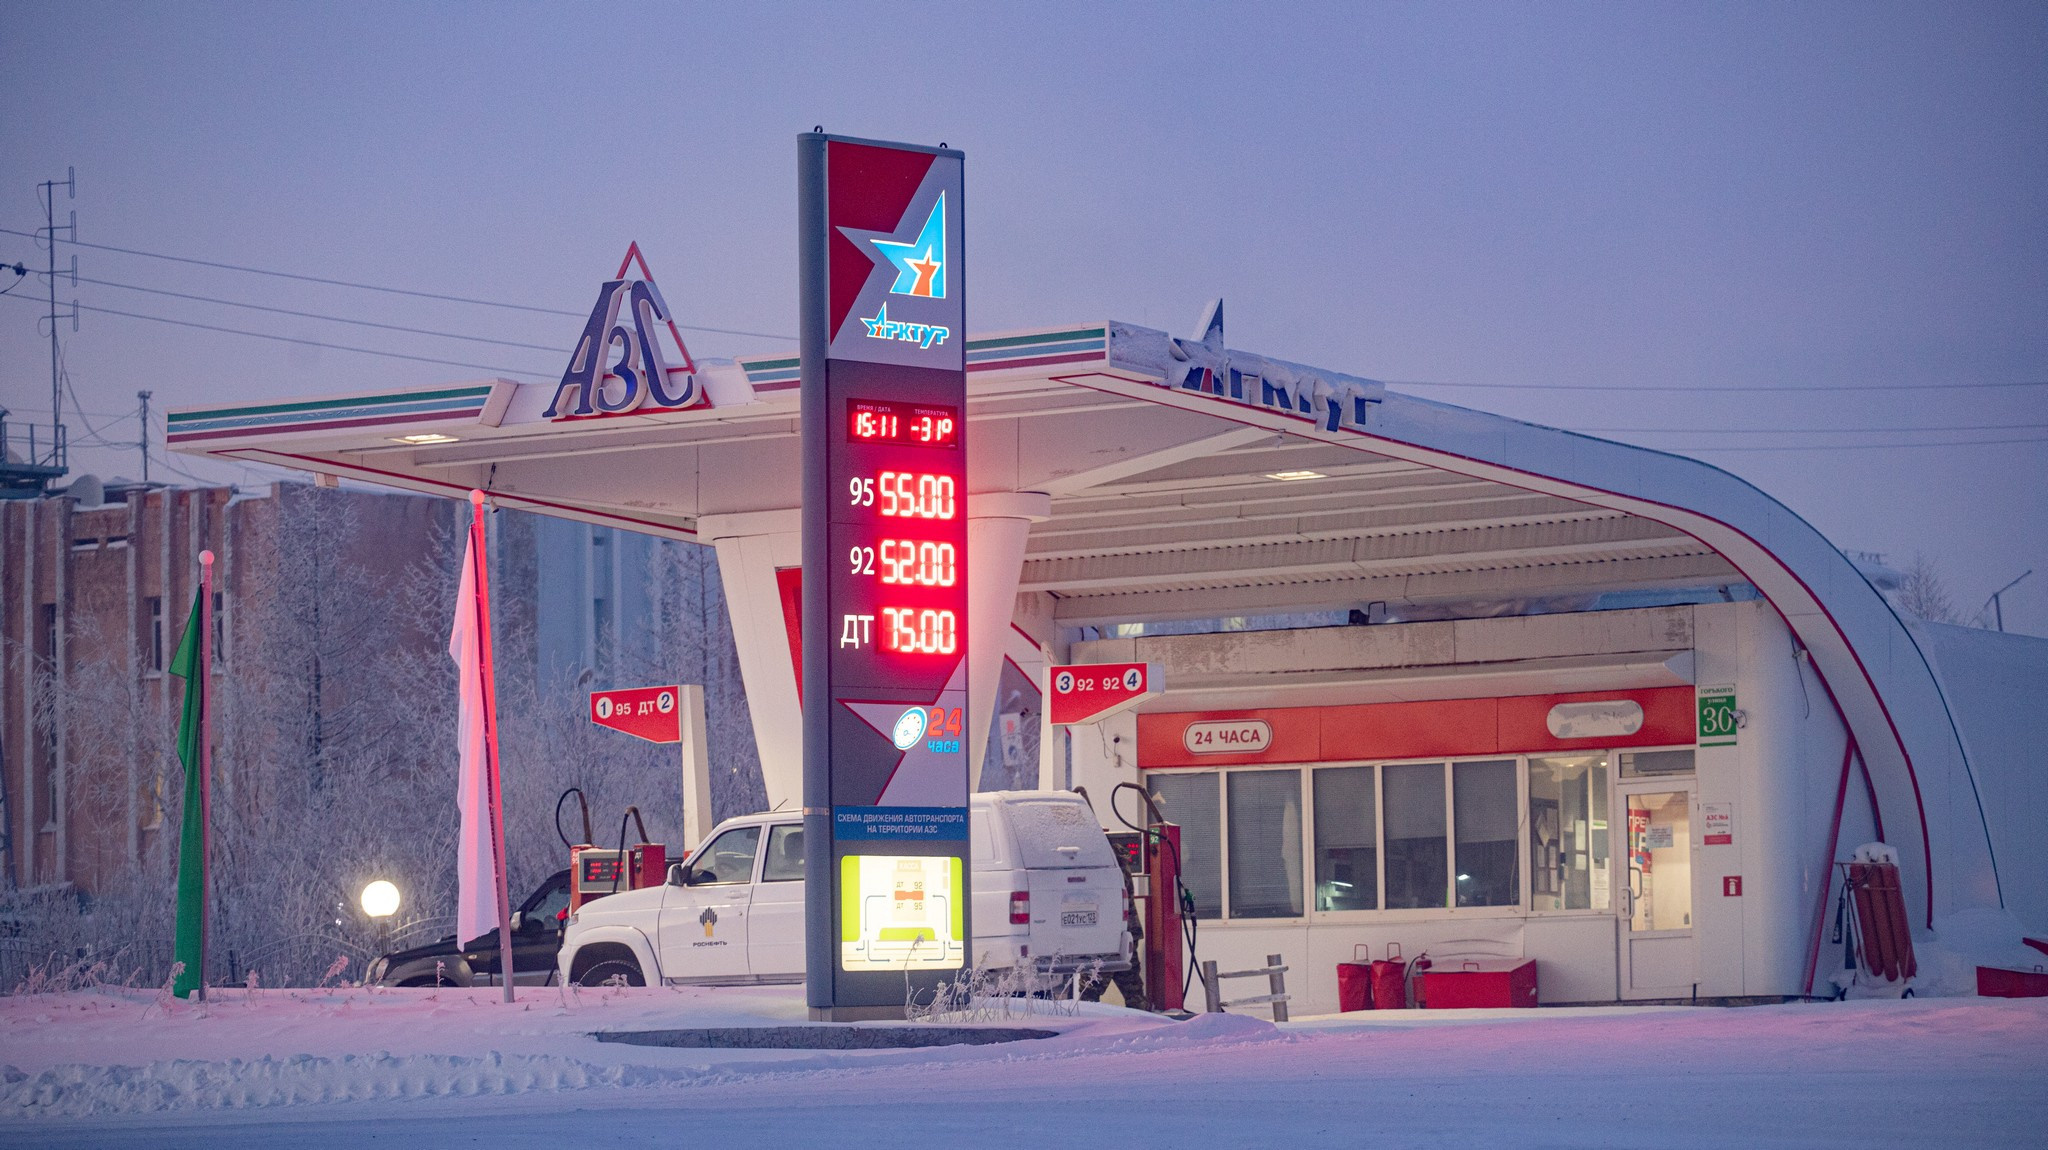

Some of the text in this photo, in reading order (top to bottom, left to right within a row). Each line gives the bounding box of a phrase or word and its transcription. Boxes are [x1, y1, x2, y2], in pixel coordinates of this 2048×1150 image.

[859, 300, 950, 349] АРКТУР
[542, 279, 701, 418] АЗС
[857, 412, 897, 437] 15:11
[849, 472, 954, 519] 95 55.00
[850, 540, 955, 586] 92 52.00
[840, 608, 955, 654] ДТ 75.00
[1060, 672, 1137, 691] 3 92 92 4
[599, 694, 670, 716] 1 95 ДТ 2
[928, 707, 962, 737] 24
[1703, 706, 1733, 733] 30
[927, 740, 960, 753] часа
[1195, 729, 1261, 745] 24 ЧАСА
[837, 813, 964, 823] СХЕМА ДВИЖЕНИЯ АВТОТРАНСПОРТА
[867, 825, 938, 834] НА ТЕРРИТОРИИ АЗС
